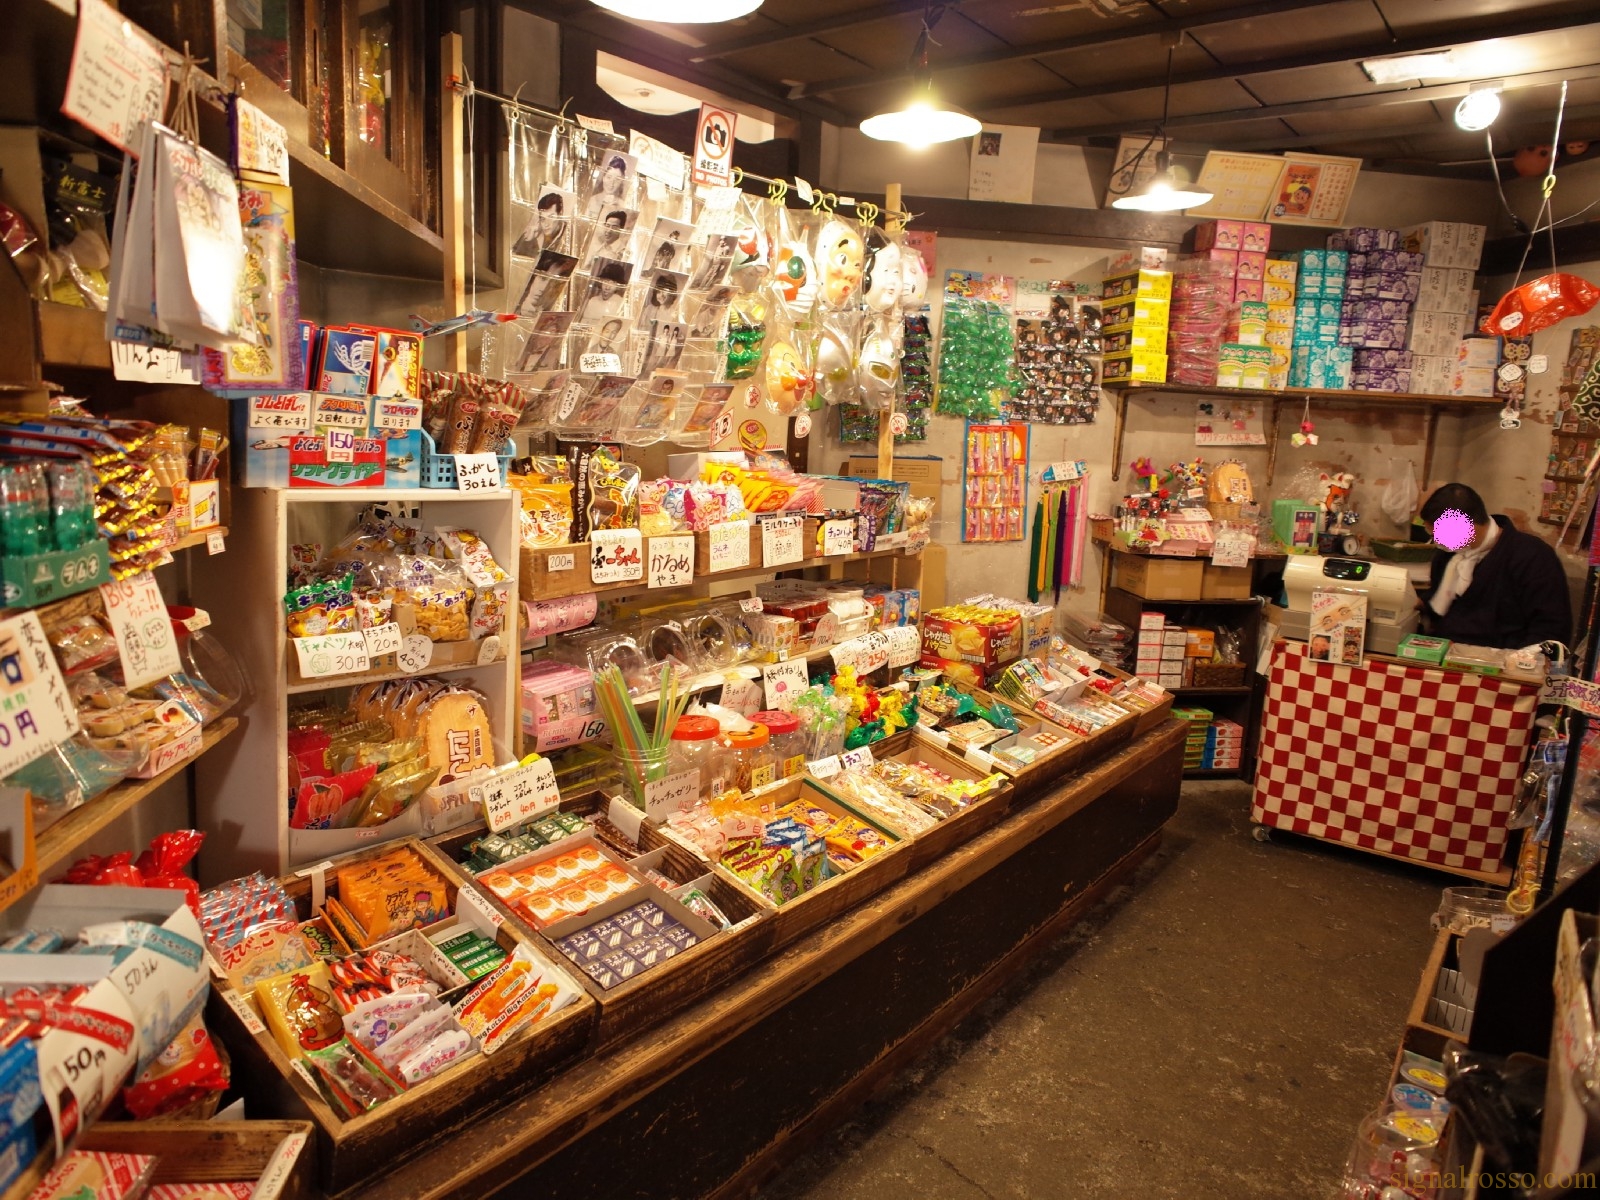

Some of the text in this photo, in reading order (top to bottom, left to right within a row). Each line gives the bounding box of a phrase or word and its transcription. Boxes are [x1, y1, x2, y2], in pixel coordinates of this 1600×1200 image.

[700, 160, 725, 174] 撮影禁止
[59, 174, 106, 198] 新富士
[316, 413, 366, 426] 2回転します
[382, 418, 411, 428] 回ります
[330, 431, 354, 449] 150
[331, 451, 351, 461] 円
[290, 462, 383, 480] ソフトグライダー
[460, 463, 496, 477] ふがし
[463, 478, 498, 491] 30えん
[713, 543, 729, 553] ラムネ
[550, 556, 573, 569] 200円
[651, 554, 690, 573] かるめ
[1355, 565, 1363, 574] 0
[622, 567, 641, 577] 350円
[656, 574, 678, 586] やき
[101, 580, 134, 608] BIG
[365, 622, 400, 638] もち太郎
[924, 627, 952, 645] じゃが塩
[374, 639, 399, 652] 20円
[924, 640, 948, 651] バター
[336, 655, 367, 670] 30円
[400, 653, 420, 670] 40円
[868, 650, 887, 667] 250
[578, 720, 605, 740] 160
[474, 727, 483, 759] 味自慢
[536, 770, 552, 783] オレンジ
[513, 780, 527, 792] ココア
[544, 794, 559, 806] 40円
[520, 801, 536, 815] 40円
[494, 811, 511, 826] 60円
[221, 931, 275, 970] えびっこ
[124, 958, 158, 995] 50えん
[63, 1046, 107, 1082] 50円
